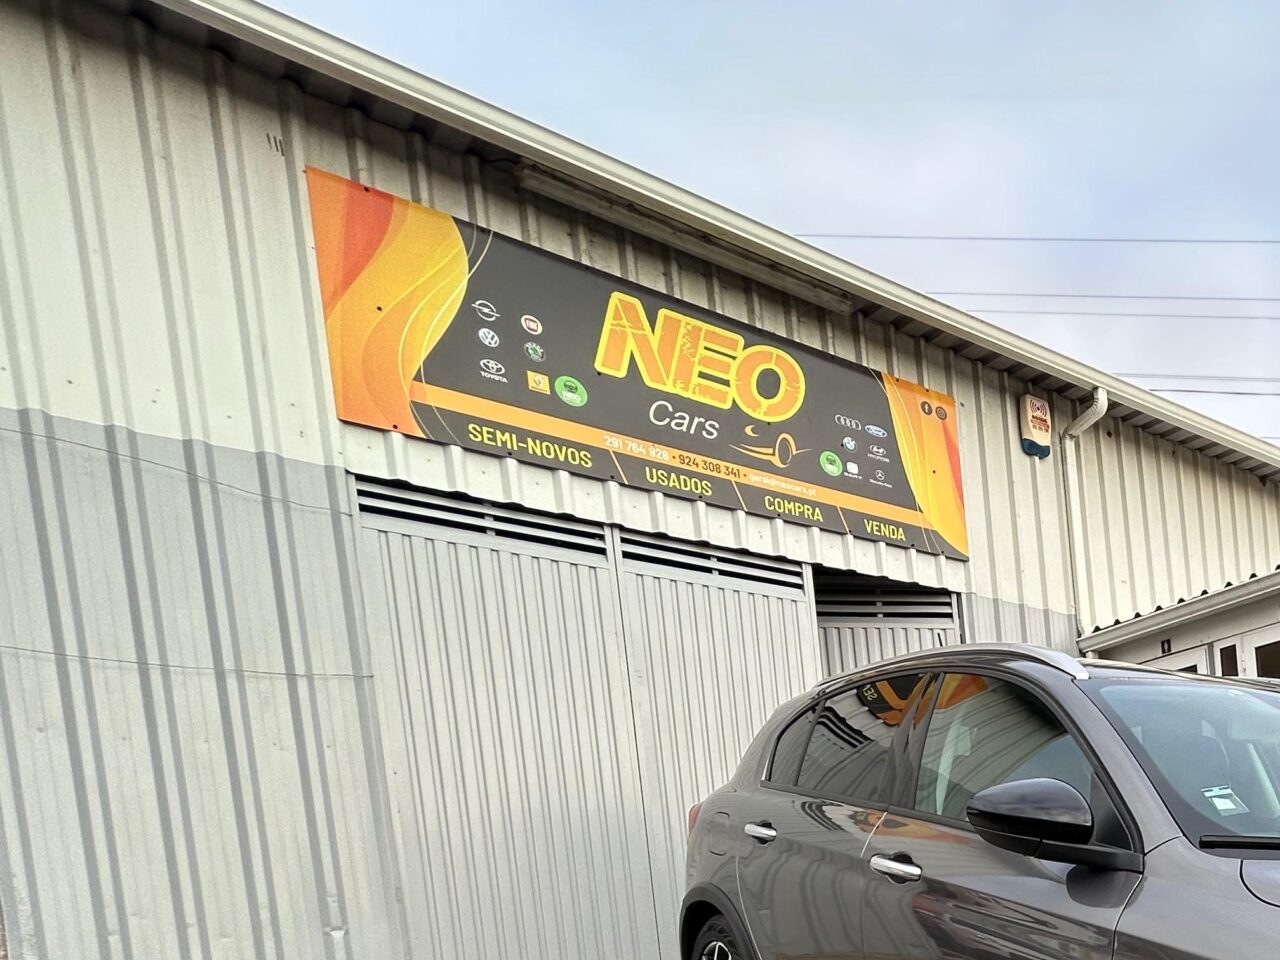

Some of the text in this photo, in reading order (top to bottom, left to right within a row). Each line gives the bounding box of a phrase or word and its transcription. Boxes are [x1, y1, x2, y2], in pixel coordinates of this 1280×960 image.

[594, 291, 806, 422] NEO
[480, 369, 508, 384] TOYOTA
[649, 400, 720, 440] Cars
[468, 423, 593, 468] SEMI-NOVOS
[625, 440, 646, 455] 764
[648, 446, 669, 461] 928
[678, 453, 699, 468] 924
[702, 460, 721, 474] 308
[724, 466, 741, 479] 341
[645, 466, 712, 496] USADOS
[764, 495, 823, 522] COMPRA
[864, 519, 906, 542] VENDA
